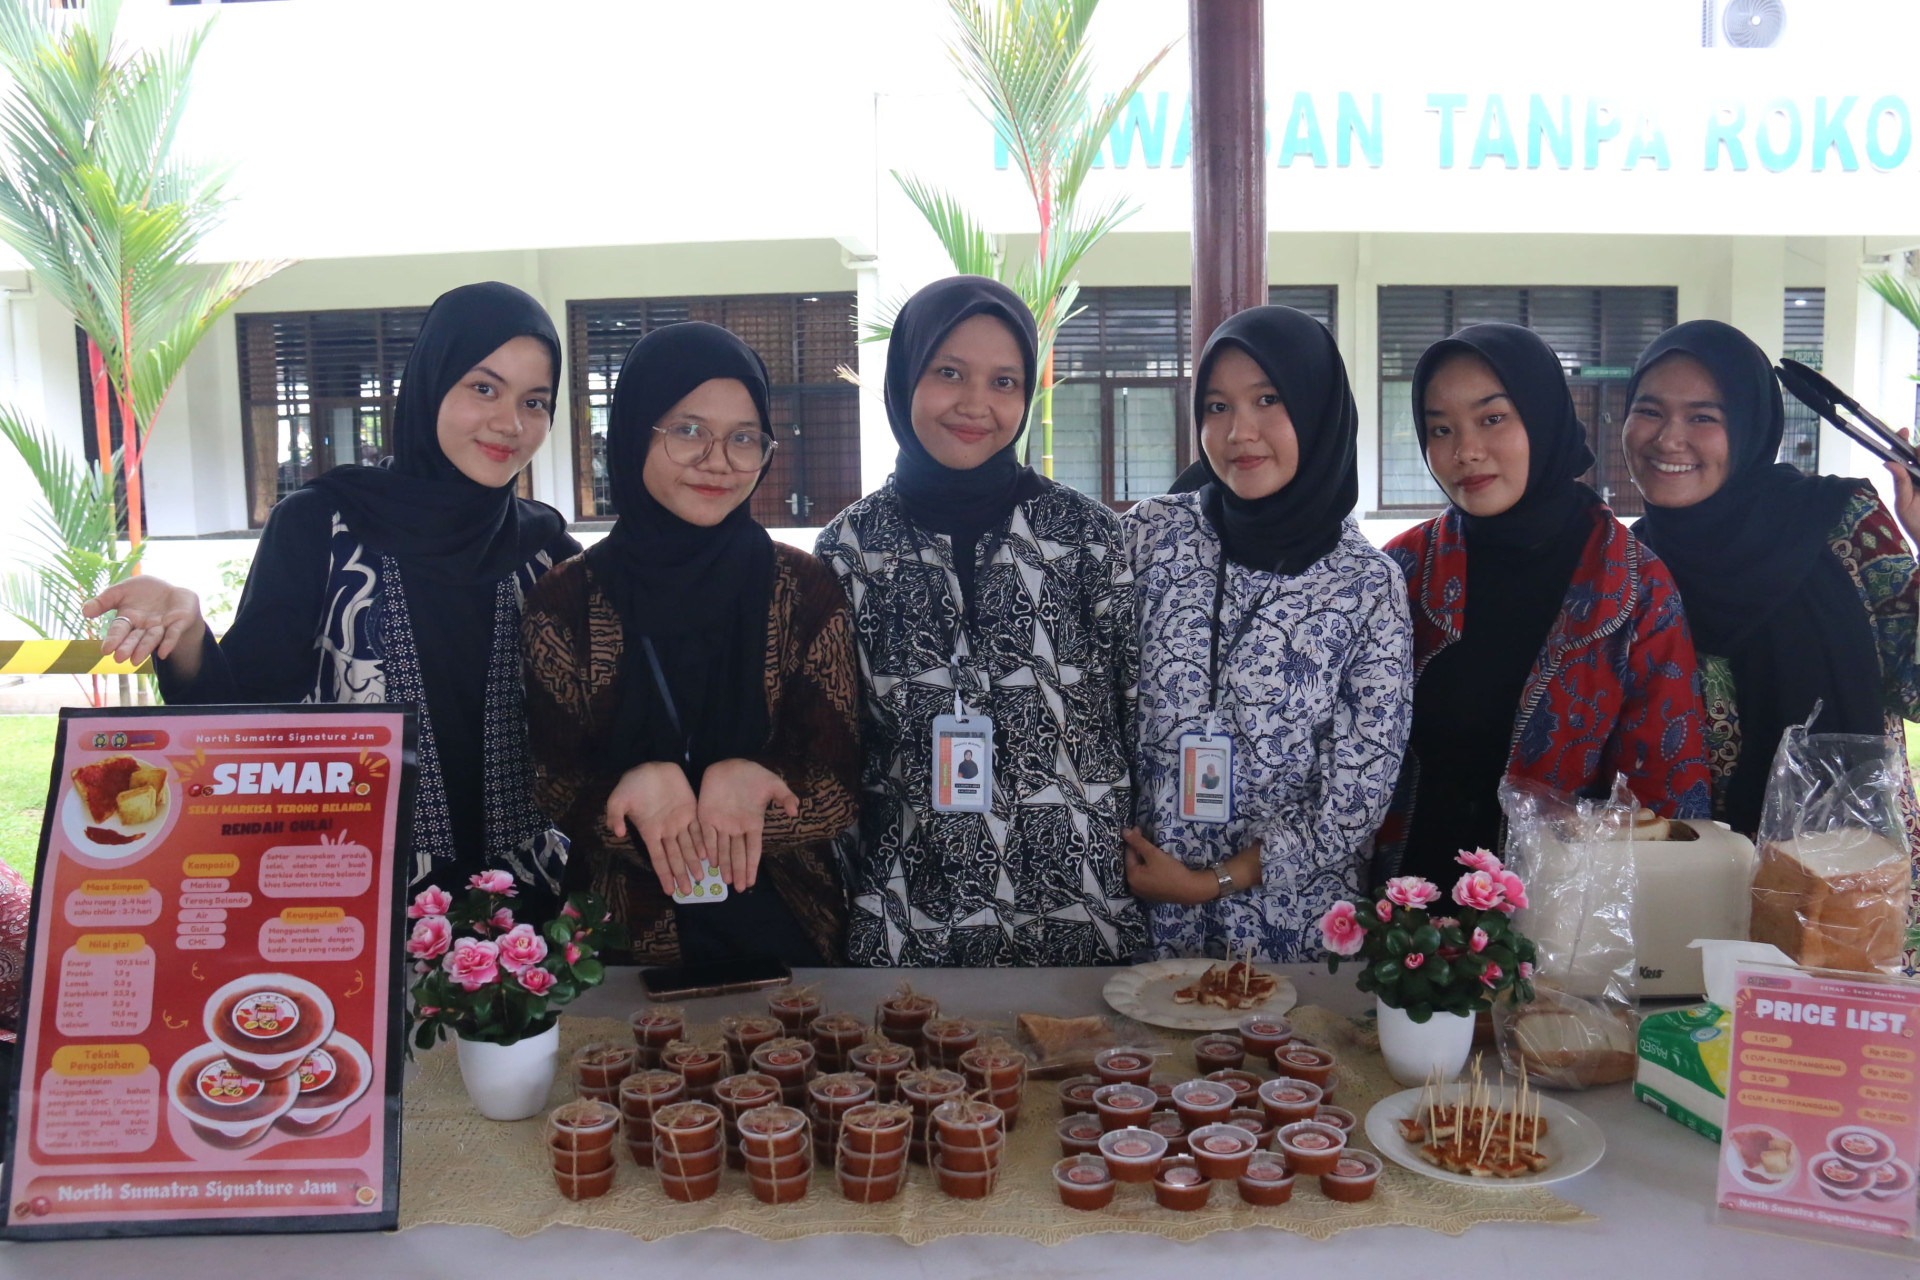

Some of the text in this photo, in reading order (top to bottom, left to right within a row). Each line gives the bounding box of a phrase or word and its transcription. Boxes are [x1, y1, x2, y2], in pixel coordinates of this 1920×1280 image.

[1425, 92, 1672, 171] TANPA
[196, 732, 375, 743] North Sumatra Signature Jam
[213, 762, 353, 795] SEMAR
[188, 803, 371, 815] SELAI MARKISA TERONG BELANDA
[221, 821, 283, 835] RENDAH
[112, 883, 144, 892] Simpan
[184, 898, 213, 906] Terong
[286, 911, 338, 920] Keunggulan
[112, 941, 129, 950] gizi
[1756, 999, 1906, 1034] PRICE LIST
[1759, 1035, 1777, 1043] CUP
[85, 1050, 120, 1059] Teknik
[1640, 1038, 1668, 1060] PASEO
[1750, 1054, 1766, 1063] CUP
[70, 1061, 134, 1072] Pengolahan
[1758, 1075, 1776, 1083] CUP
[1747, 1094, 1763, 1102] CUP
[57, 1179, 337, 1202] North Sumatra Signature Jam
[1772, 1203, 1814, 1218] Sumatra
[1817, 1210, 1867, 1227] Signature
[1869, 1220, 1892, 1231] Jam
